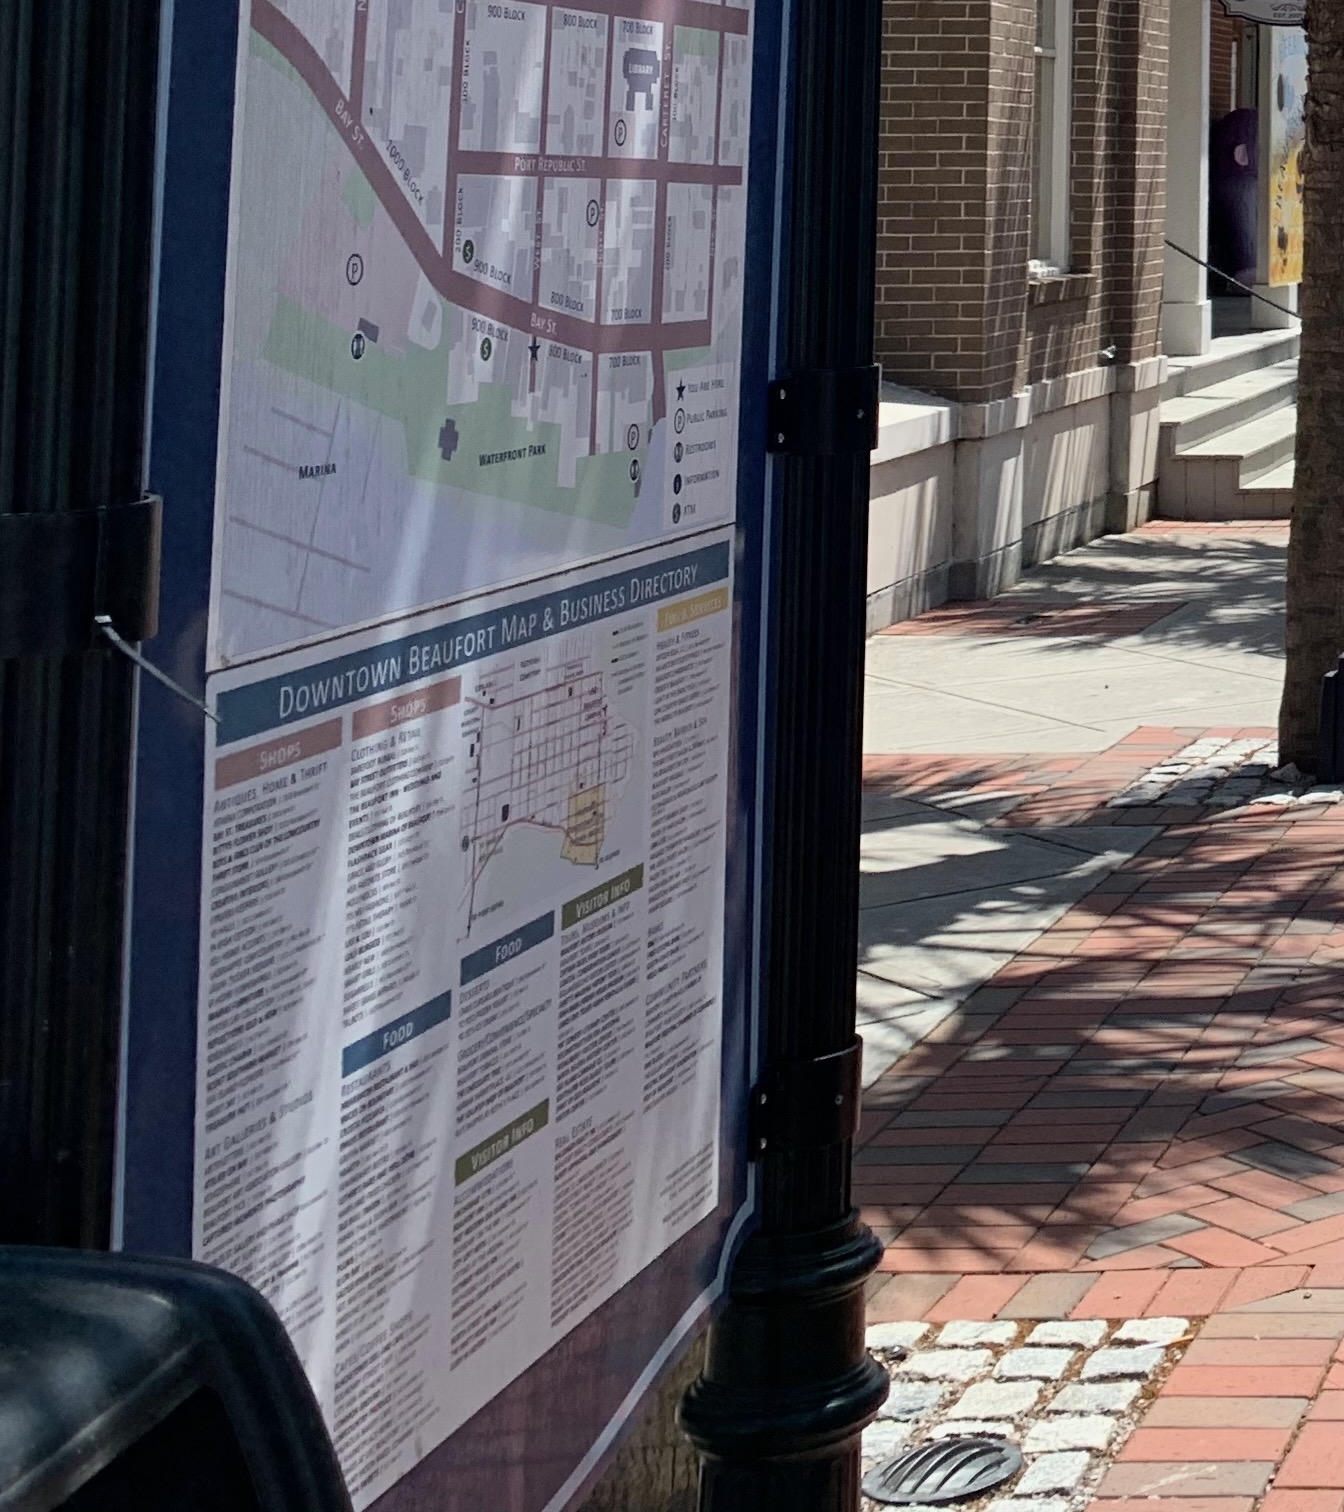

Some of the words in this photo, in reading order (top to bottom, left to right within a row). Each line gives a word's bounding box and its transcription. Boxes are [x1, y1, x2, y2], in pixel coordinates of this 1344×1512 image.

[504, 7, 526, 21] BLOCK
[578, 16, 598, 29] BLOCK
[628, 63, 653, 74] LIBRARY
[335, 100, 353, 127] BAY
[386, 139, 405, 171] 1000
[403, 168, 425, 206] BLOCK
[514, 156, 536, 171] PORT
[538, 156, 575, 171] REPUBLIC
[474, 259, 489, 276] 900
[490, 265, 512, 285] BLOCK
[565, 297, 584, 312] BLOCK
[624, 308, 643, 320] BLOCK
[471, 318, 486, 332] 900
[487, 323, 509, 341] BLOCK
[530, 312, 545, 328] BAY
[622, 355, 641, 367] BLOCK
[686, 412, 705, 424] PUBLIC
[706, 408, 728, 420] PARKING
[479, 447, 527, 466] WATERFRONT
[528, 444, 546, 457] PARK
[299, 463, 337, 480] MARINA
[279, 658, 401, 719] DOWNTOWN
[408, 625, 497, 676] BEAUFORT
[501, 614, 538, 646] MAP
[543, 607, 554, 631] &
[560, 586, 626, 627] BUSINESS
[629, 563, 698, 603] DIRECTORY
[390, 695, 426, 723] SHOPS
[259, 739, 301, 771] SHOPS
[576, 887, 608, 919] VISITOR
[610, 875, 630, 900] INFO
[495, 933, 522, 963] FOOD
[382, 1017, 413, 1051] FOOD
[471, 1131, 509, 1171] VISITOR
[511, 1114, 534, 1143] INFO
